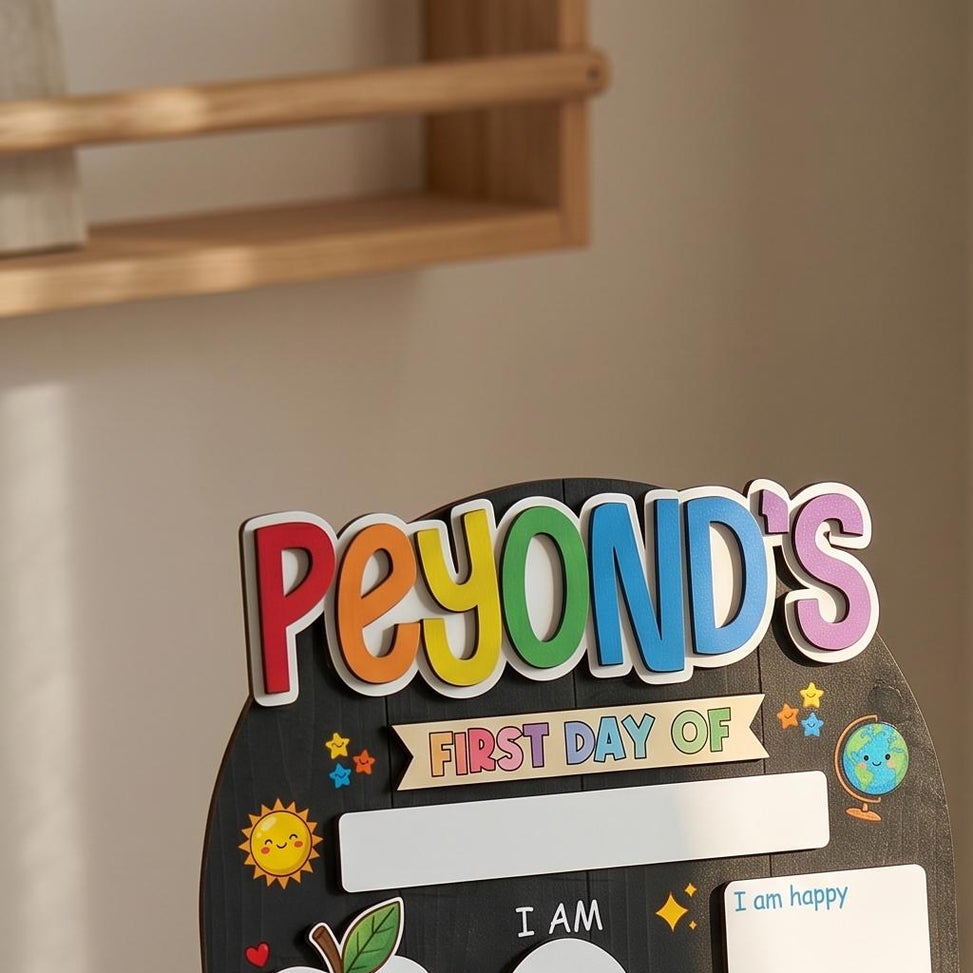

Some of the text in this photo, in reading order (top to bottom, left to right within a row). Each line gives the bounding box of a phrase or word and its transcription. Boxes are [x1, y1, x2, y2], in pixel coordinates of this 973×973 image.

[429, 707, 732, 778] FIRST DAY OF
[735, 882, 848, 913] I am happy
[517, 900, 603, 937] I AM
